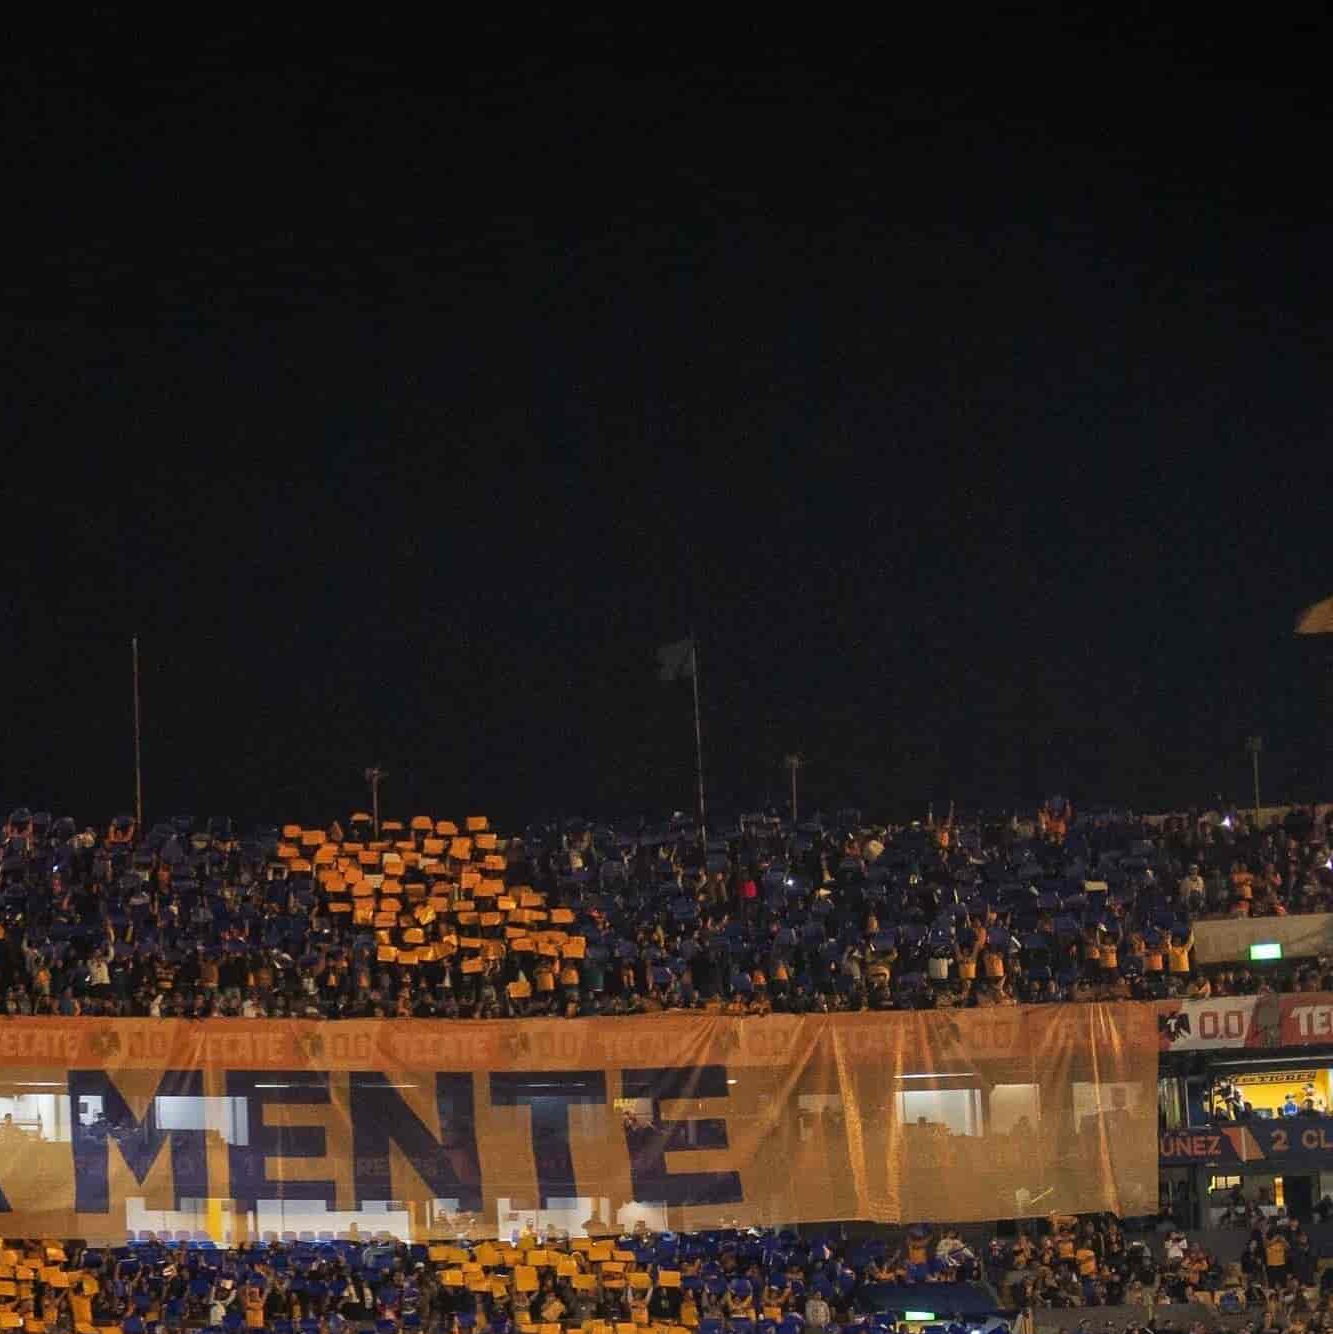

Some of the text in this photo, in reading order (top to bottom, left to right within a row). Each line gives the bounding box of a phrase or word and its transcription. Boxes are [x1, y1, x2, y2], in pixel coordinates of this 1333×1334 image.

[1199, 1010, 1244, 1040] 0.0
[67, 1064, 745, 1214] MENTE
[1272, 1129, 1289, 1151] 2
